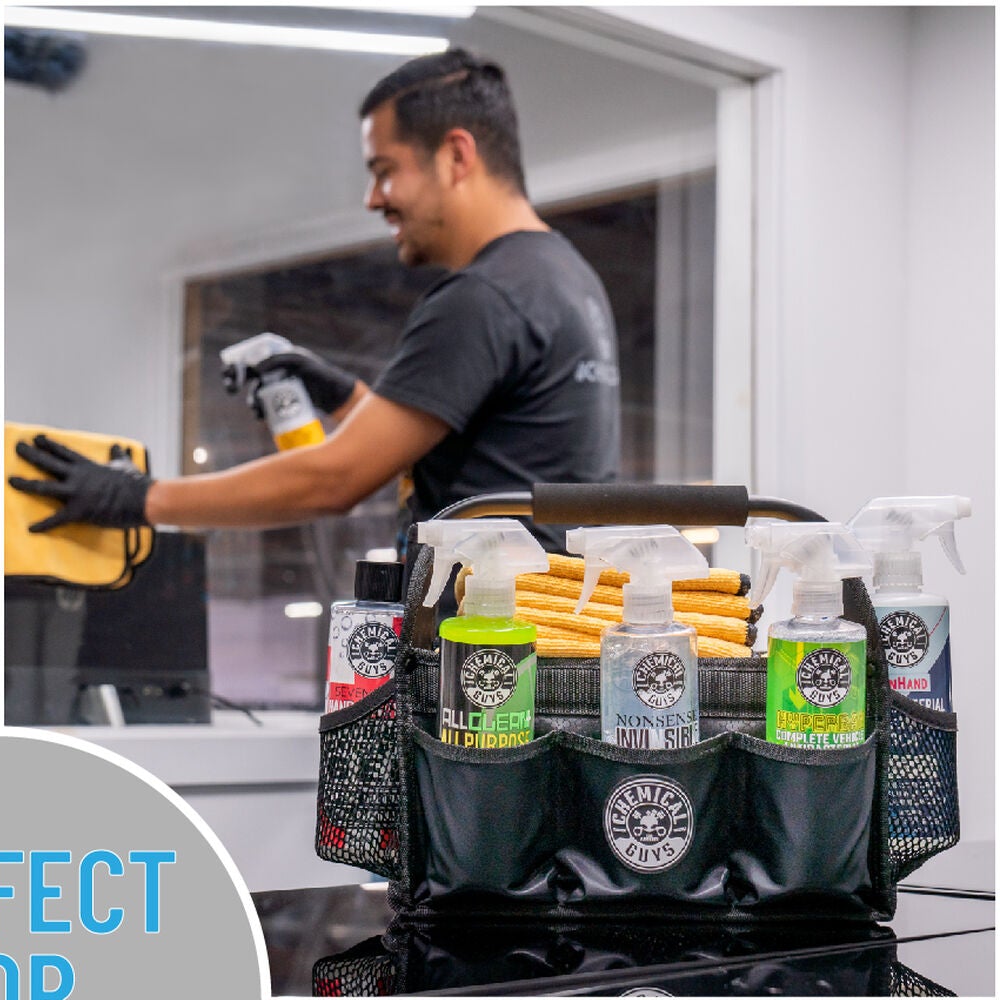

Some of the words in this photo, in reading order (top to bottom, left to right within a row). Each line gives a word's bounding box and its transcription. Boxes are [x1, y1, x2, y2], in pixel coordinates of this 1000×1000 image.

[352, 627, 396, 651] CHEMICAL
[358, 662, 387, 674] GUYS
[465, 655, 513, 679] CHEMICAL
[637, 655, 684, 682] CHEMICAL
[801, 654, 850, 679] CHEMICAL
[889, 676, 928, 690] NHAND
[473, 691, 503, 703] GUYS
[648, 693, 675, 706] GUYS
[809, 689, 841, 702] GUYS
[616, 710, 697, 727] NONSENSE
[776, 729, 829, 744] COMPLETE
[612, 786, 687, 825] CHEMICAL
[625, 842, 675, 862] GUYS
